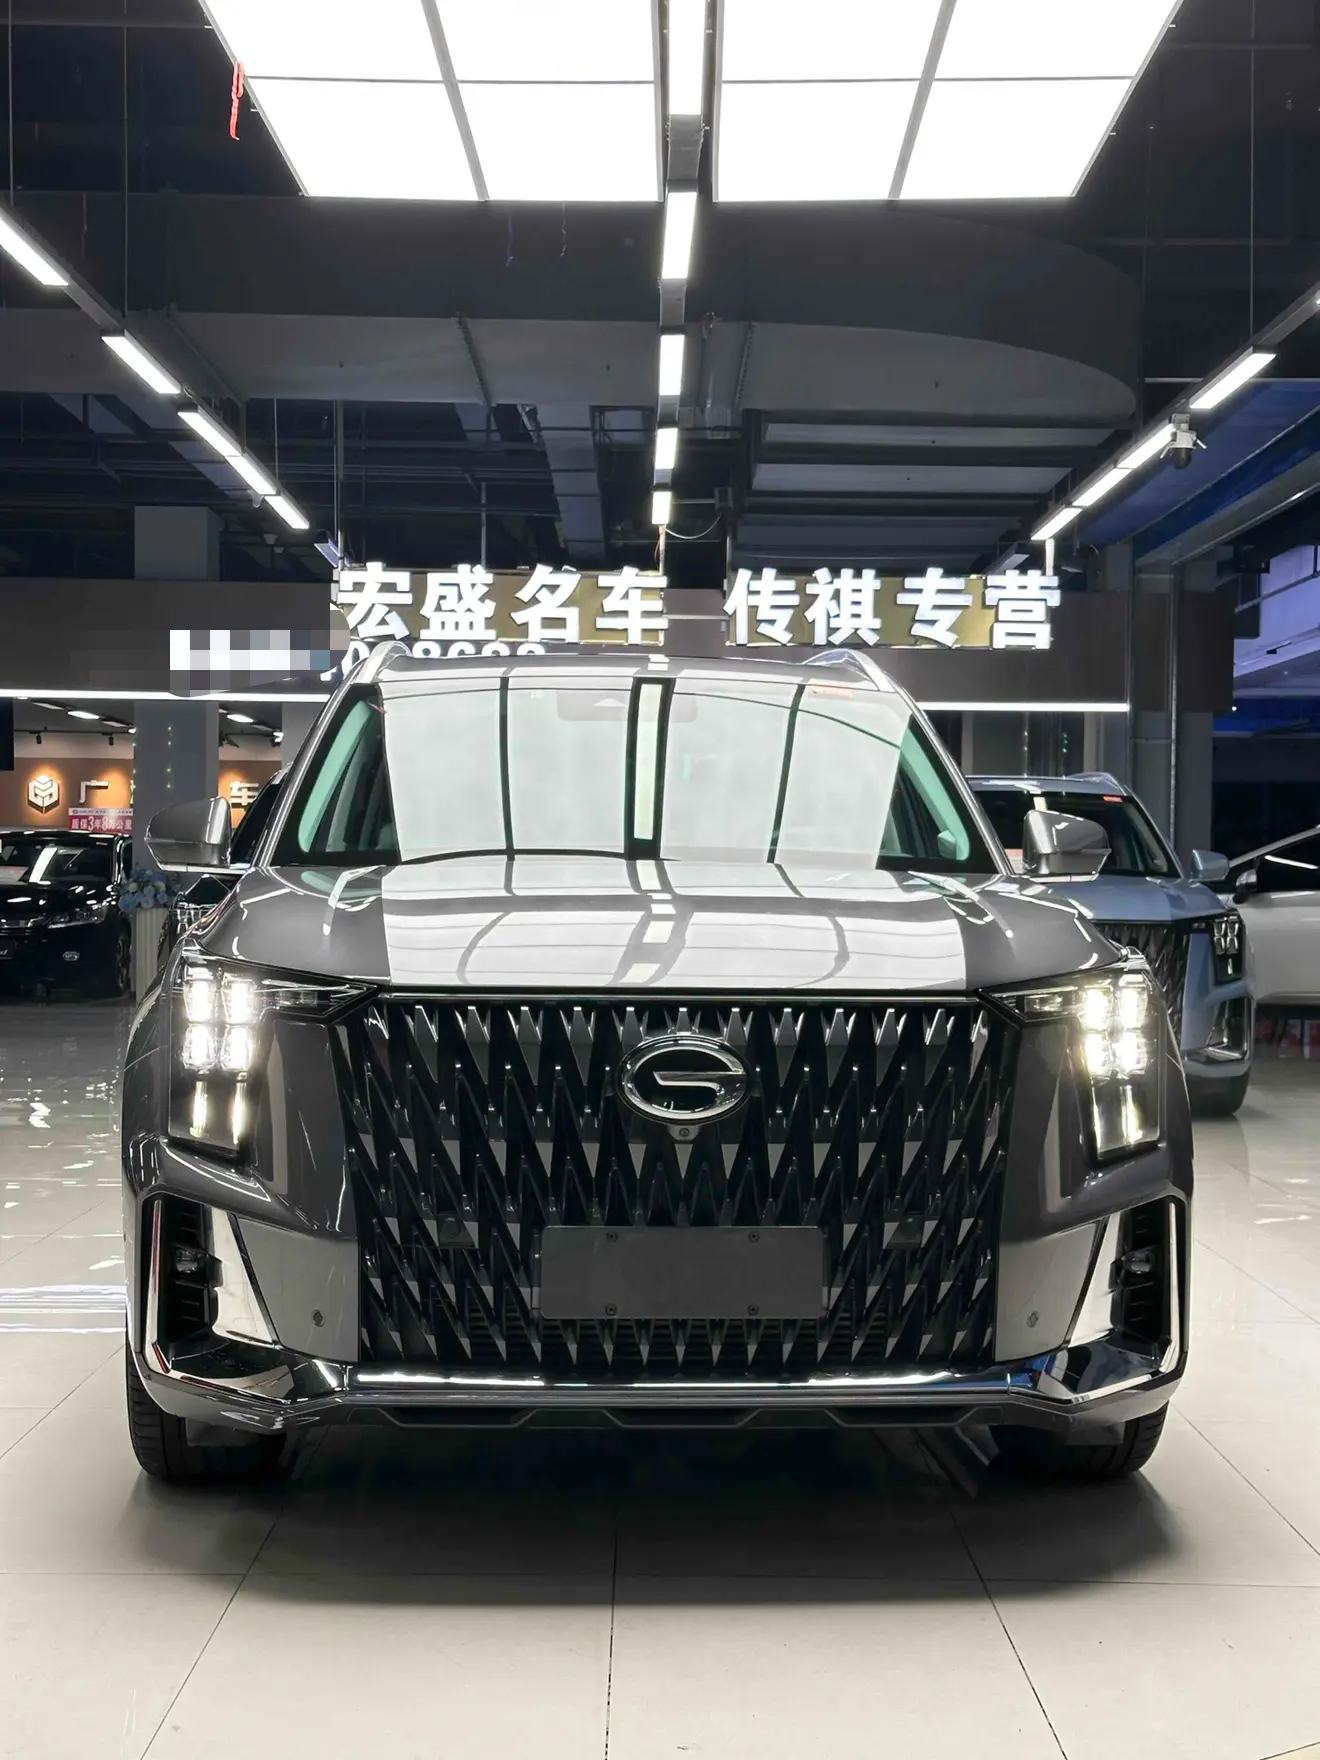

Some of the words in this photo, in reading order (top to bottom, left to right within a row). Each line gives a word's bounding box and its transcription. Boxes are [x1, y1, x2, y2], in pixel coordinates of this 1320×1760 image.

[337, 562, 668, 645] 宏盛名车
[723, 567, 1061, 650] 传祺专营
